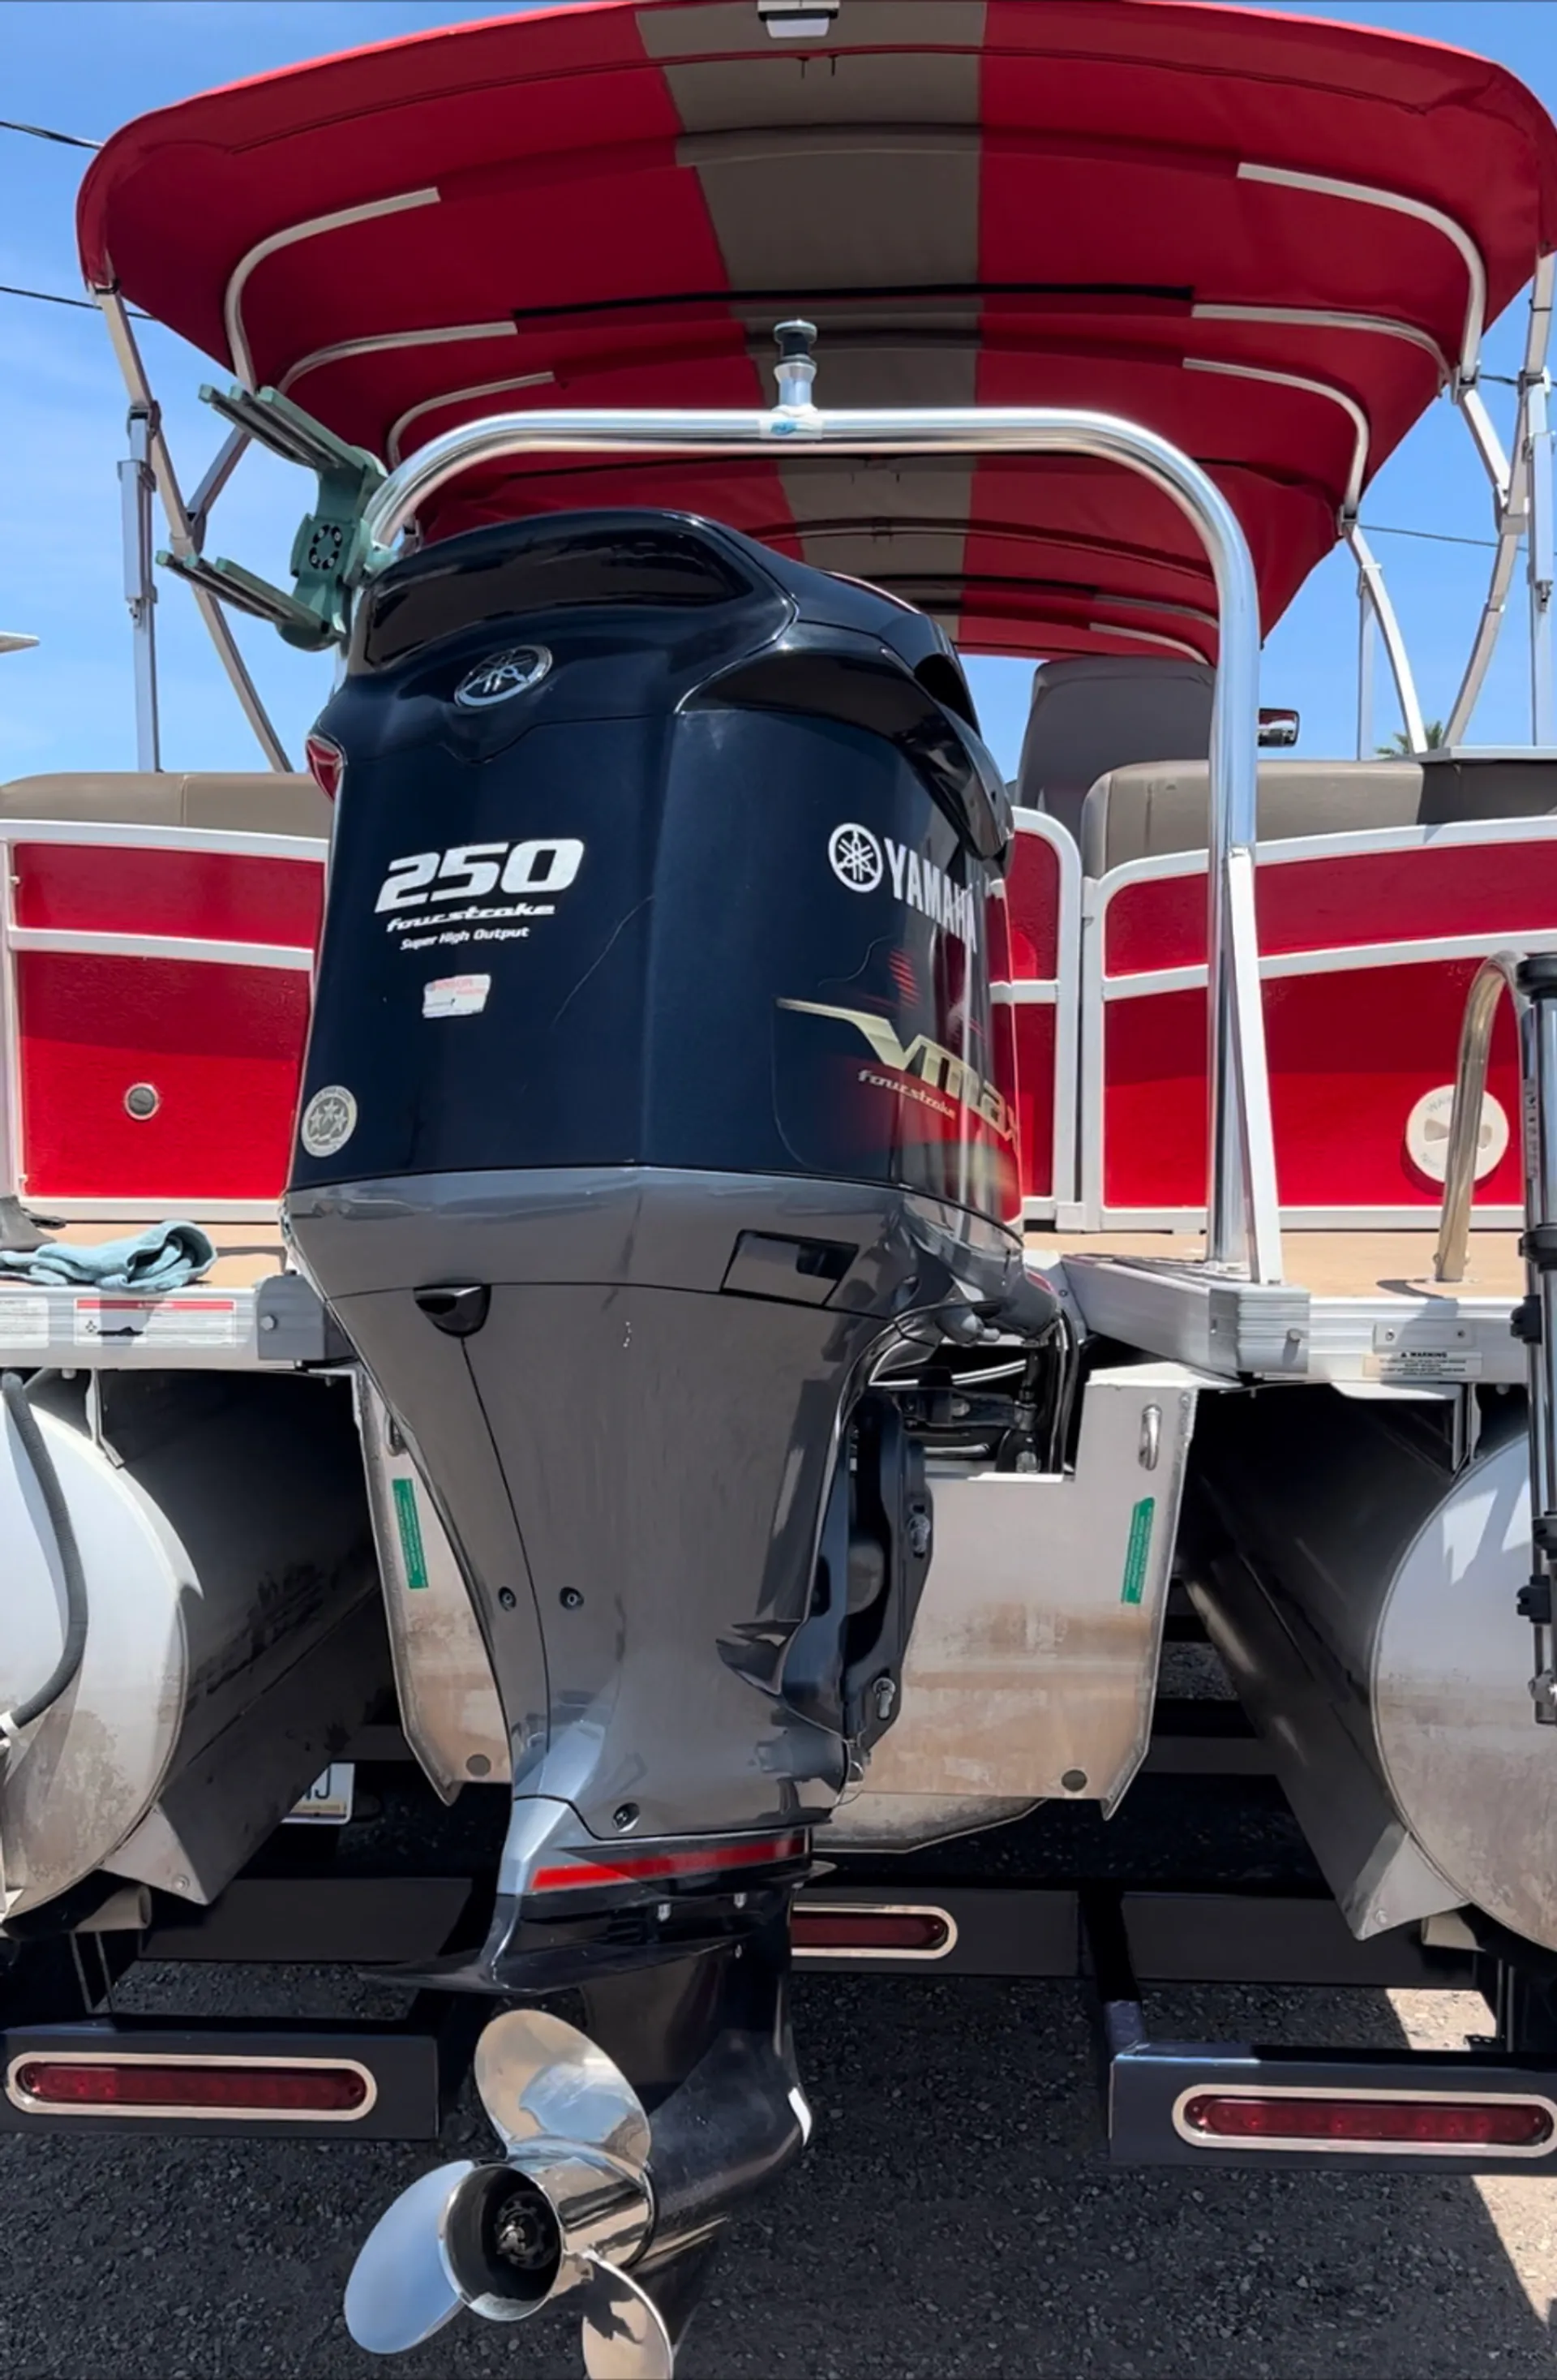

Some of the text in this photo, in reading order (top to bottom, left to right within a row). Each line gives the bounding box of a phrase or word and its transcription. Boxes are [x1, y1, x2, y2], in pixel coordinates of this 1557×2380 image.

[374, 838, 585, 913] 250
[386, 902, 555, 932] fourstroke
[400, 926, 530, 950] Super High Output
[858, 1069, 957, 1120] fourstroke
